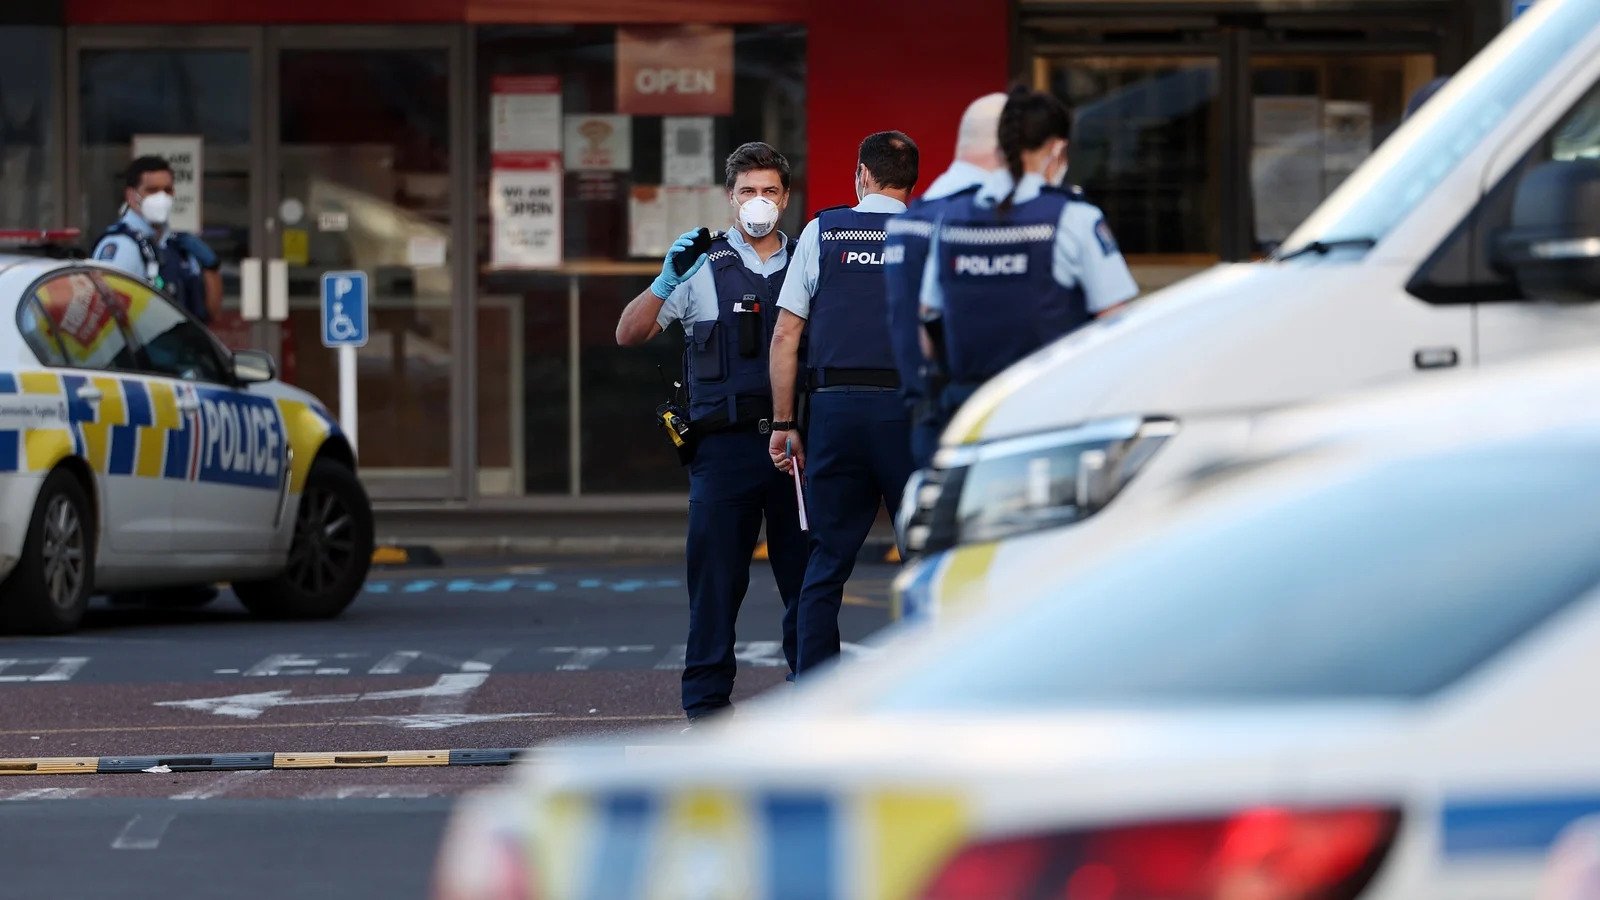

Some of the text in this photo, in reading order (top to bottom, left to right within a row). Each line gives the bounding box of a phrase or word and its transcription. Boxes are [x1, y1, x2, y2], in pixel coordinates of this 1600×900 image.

[634, 68, 715, 95] OPEN
[846, 251, 885, 265] POLI
[955, 254, 1028, 275] POLICE
[334, 277, 353, 300] P
[202, 398, 279, 476] POLICE
